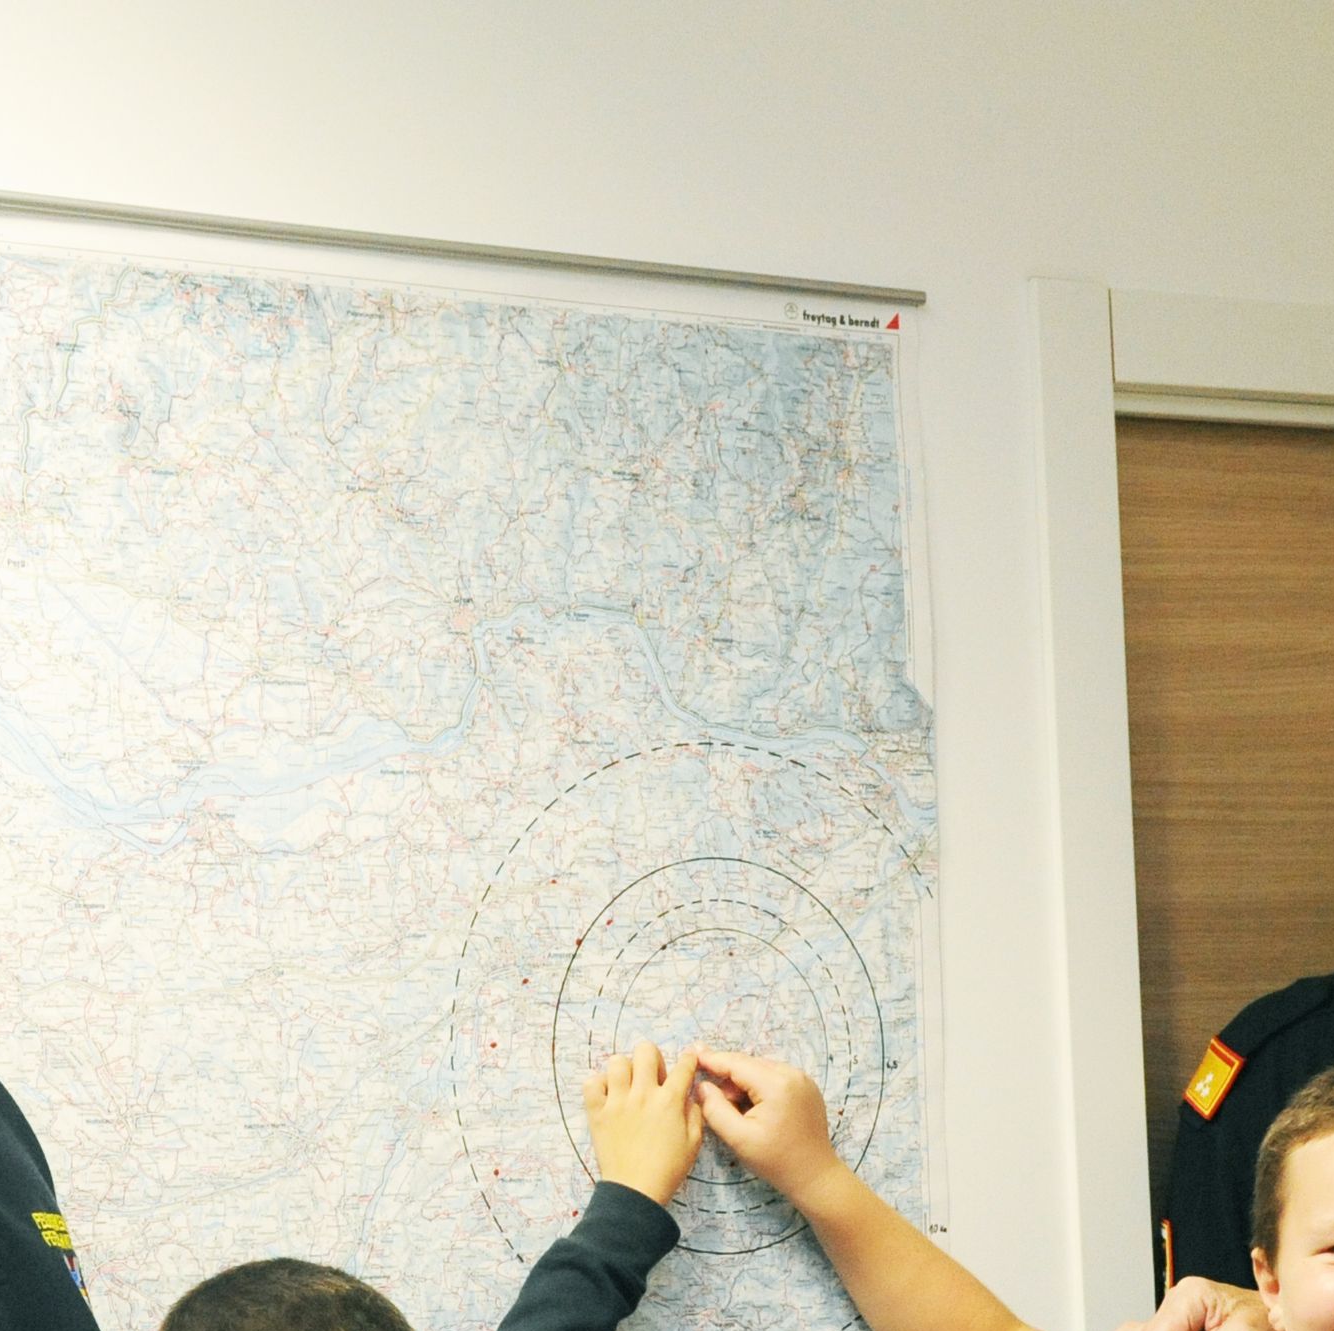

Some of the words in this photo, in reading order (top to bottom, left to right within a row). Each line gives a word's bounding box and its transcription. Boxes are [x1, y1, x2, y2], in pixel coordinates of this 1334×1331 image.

[803, 309, 836, 327] freytag
[839, 314, 846, 325] &
[848, 314, 880, 328] berndt
